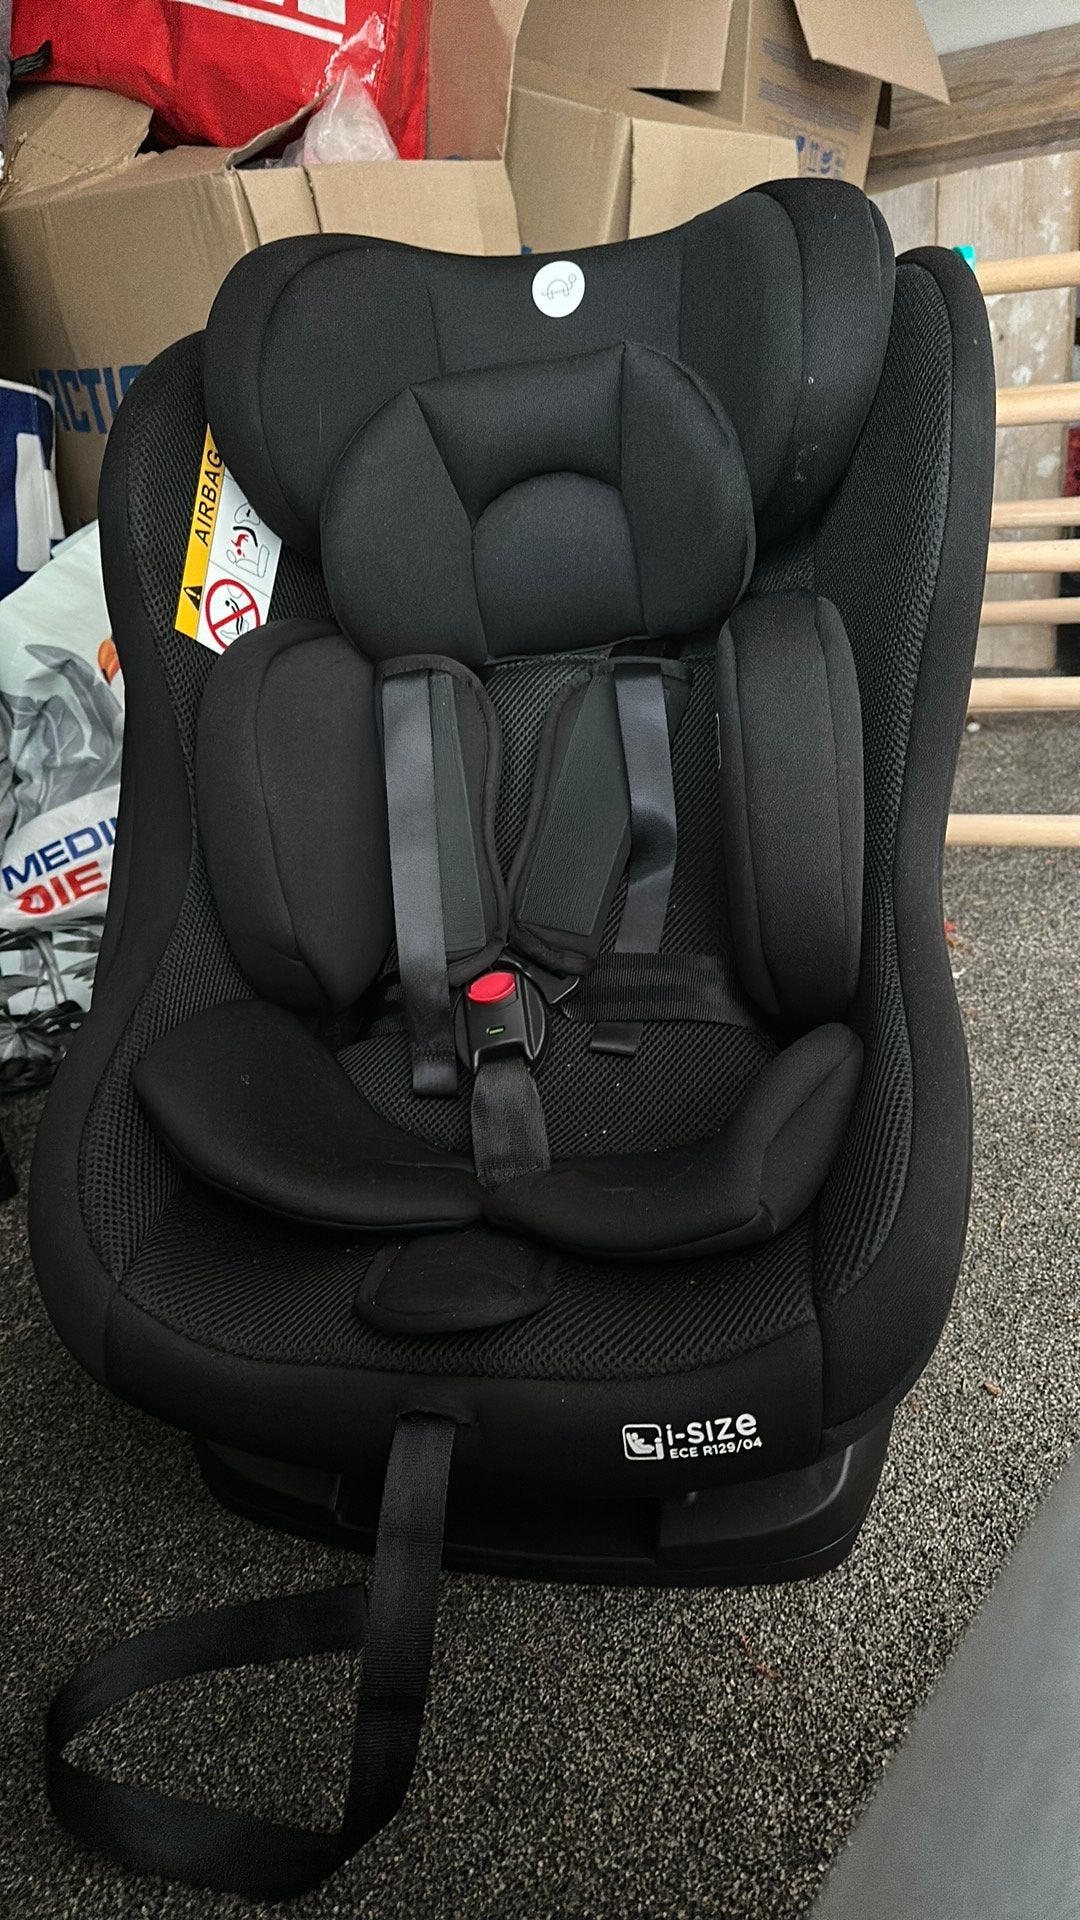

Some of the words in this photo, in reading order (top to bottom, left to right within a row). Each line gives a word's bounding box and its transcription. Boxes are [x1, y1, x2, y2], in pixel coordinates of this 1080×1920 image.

[195, 449, 223, 547] AIRBAG
[2, 816, 118, 892] MEDI
[669, 1446, 699, 1460] ECE
[702, 1436, 763, 1457] R129/04
